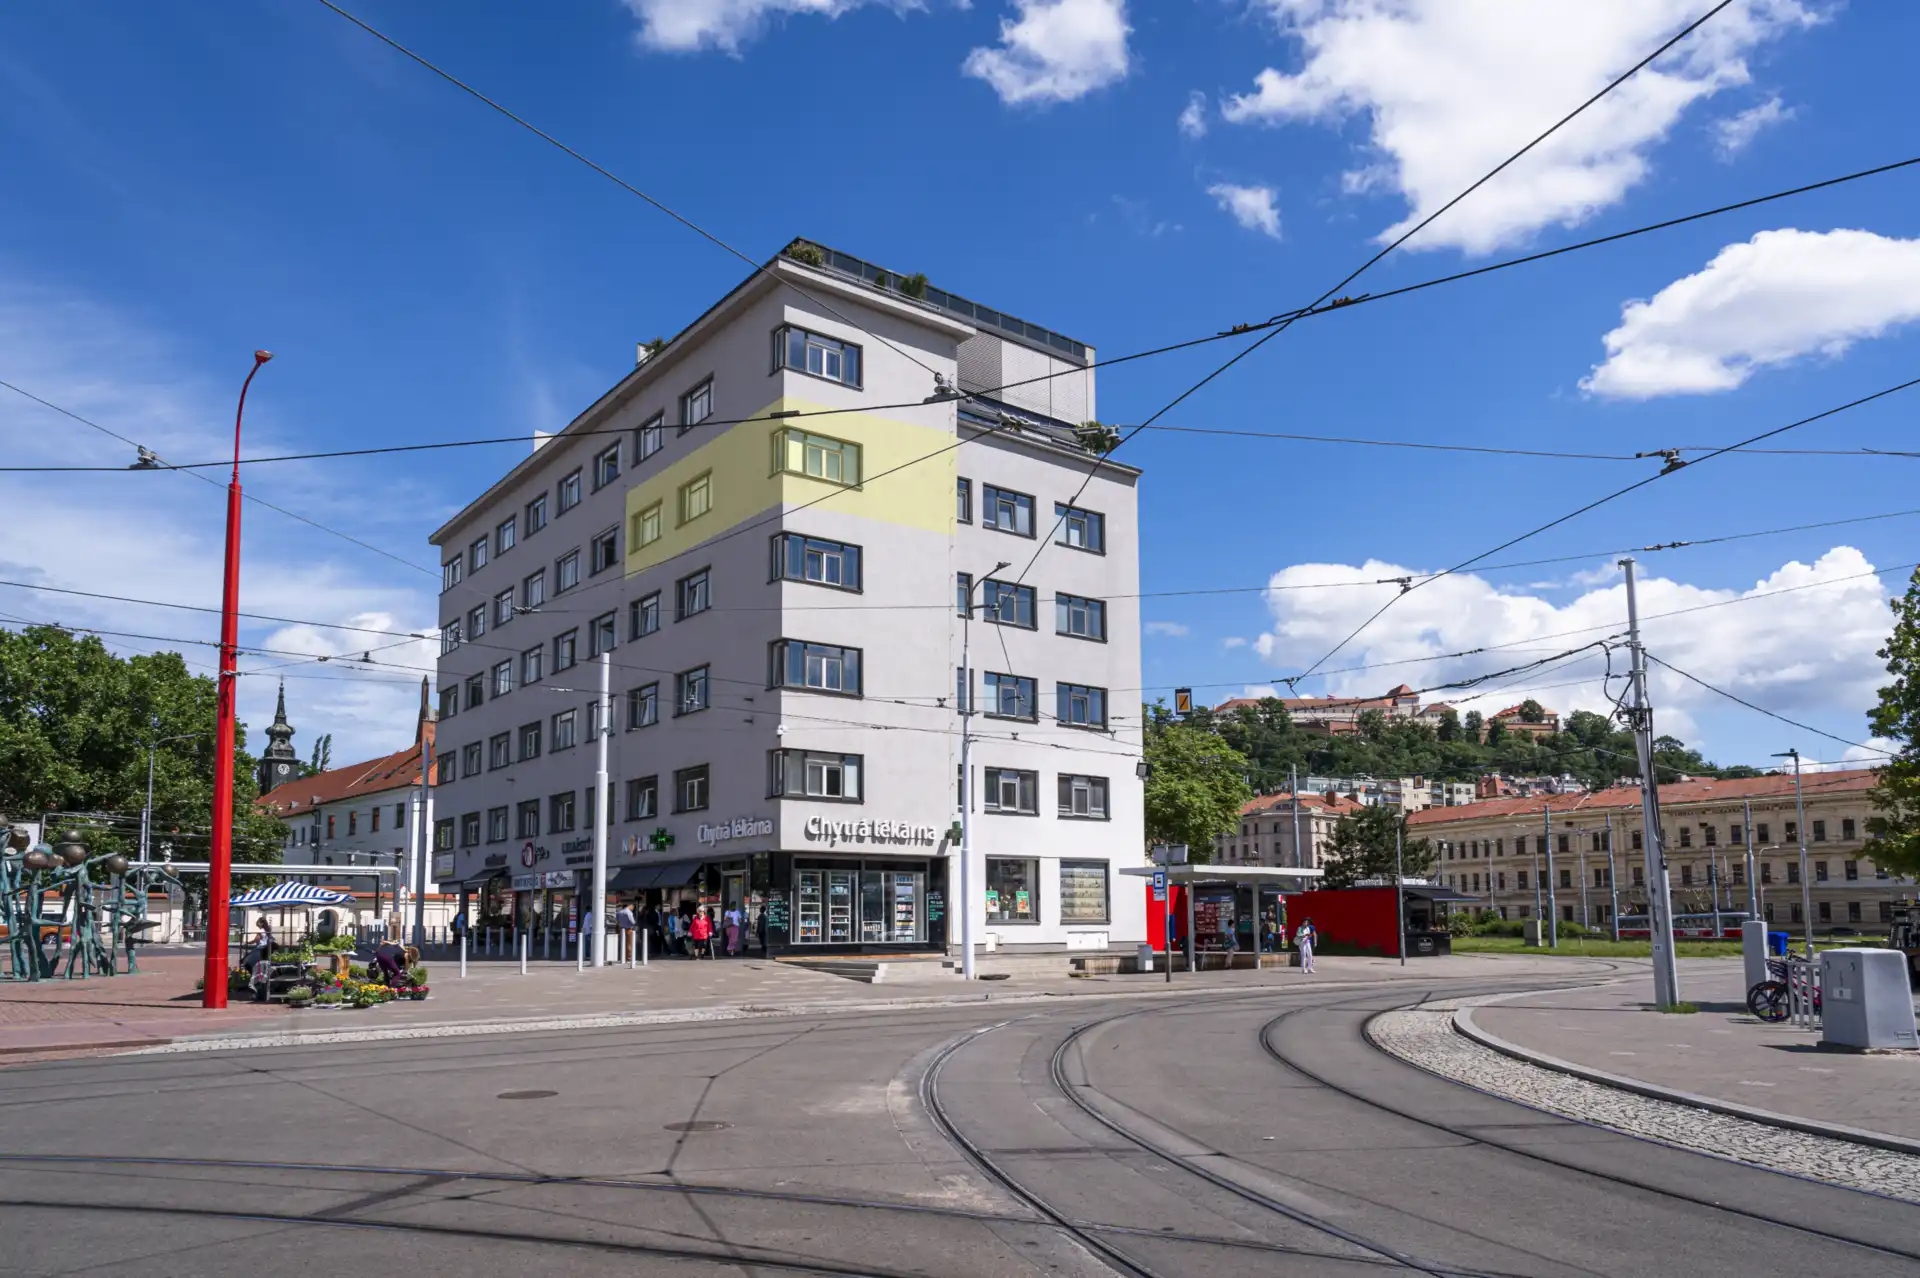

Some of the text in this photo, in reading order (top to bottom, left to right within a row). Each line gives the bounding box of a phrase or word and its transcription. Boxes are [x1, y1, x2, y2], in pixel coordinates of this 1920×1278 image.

[697, 817, 773, 846] Chytrá lékárna
[807, 815, 937, 841] Chytrá lékárna
